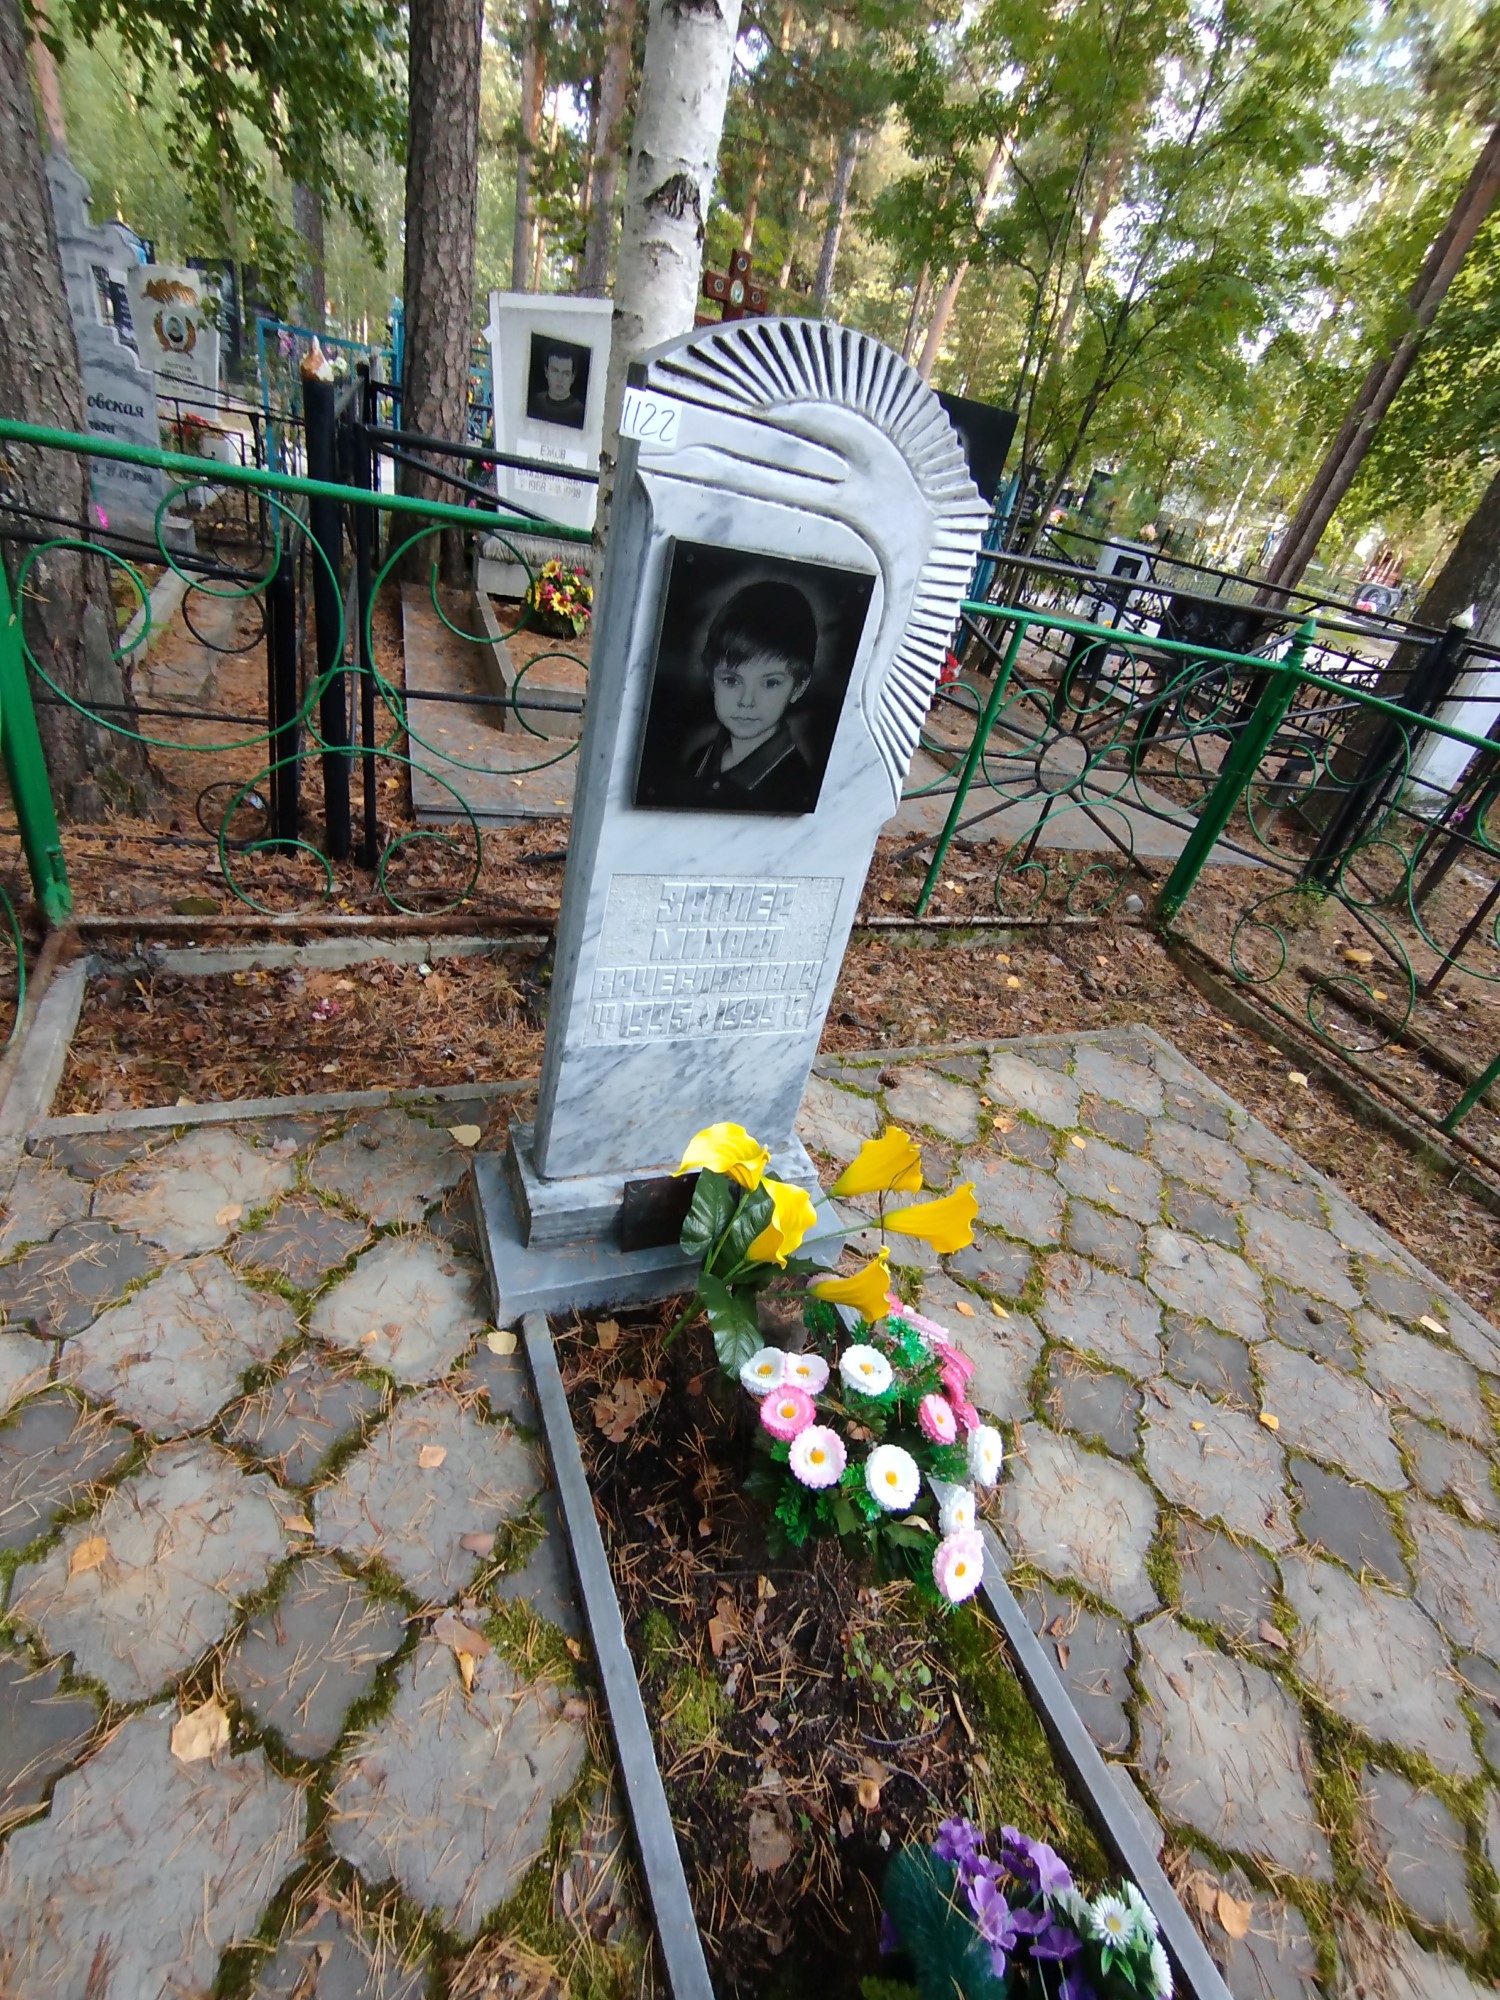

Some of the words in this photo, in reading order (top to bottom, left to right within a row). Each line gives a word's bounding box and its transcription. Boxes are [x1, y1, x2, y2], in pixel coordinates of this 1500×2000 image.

[86, 392, 145, 418] овская
[623, 395, 676, 442] 1122
[649, 926, 786, 961] МИХАИЛ
[590, 960, 823, 999] ВЯЧЕСЛАВОВИЧ
[619, 1000, 693, 1038] 1995
[714, 996, 784, 1031] 1999
